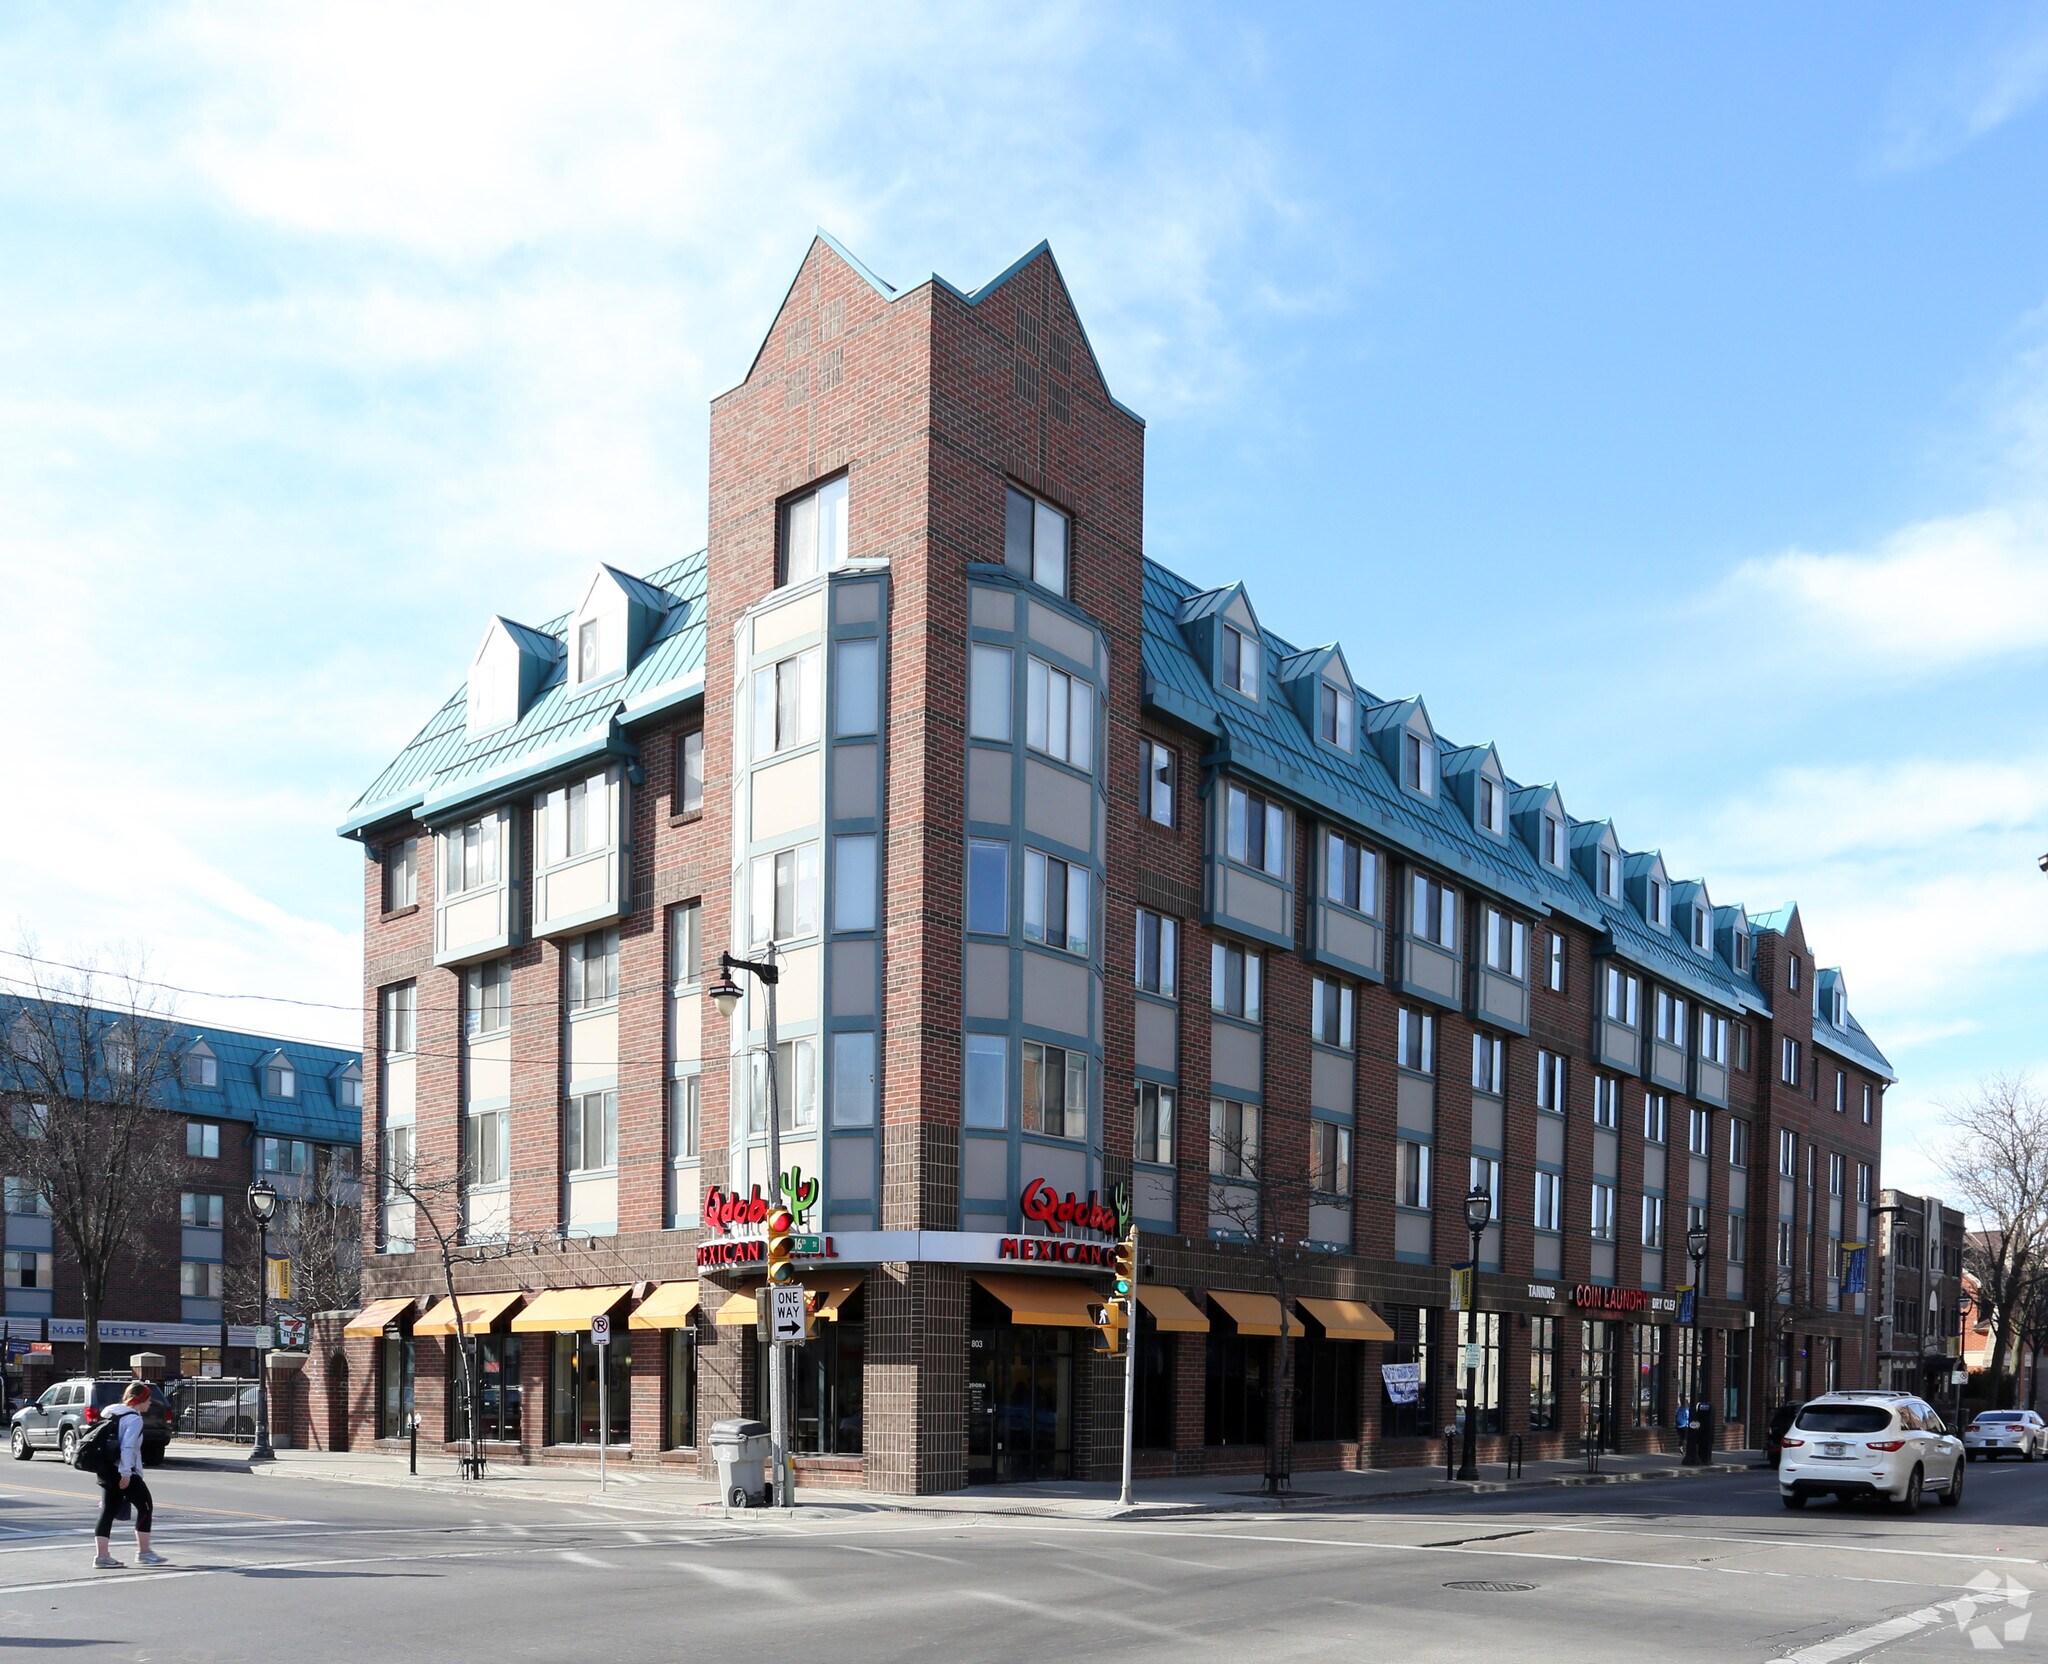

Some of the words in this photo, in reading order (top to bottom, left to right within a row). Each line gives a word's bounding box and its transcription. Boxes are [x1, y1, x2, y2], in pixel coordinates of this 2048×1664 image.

[703, 1184, 769, 1236] Qdob
[1020, 1177, 1116, 1234] Qdoba
[697, 1240, 764, 1266] MEXICAN
[999, 1237, 1102, 1265] MEXICAN
[778, 1292, 799, 1304] ONE
[1528, 1284, 1556, 1300] TANNING
[1576, 1284, 1602, 1307] COIN
[1604, 1288, 1648, 1311] LAUNDRY
[1652, 1297, 1663, 1310] DRY
[777, 1306, 800, 1318] WAY
[52, 1325, 148, 1337] MARUETTE
[971, 1340, 983, 1348] 803
